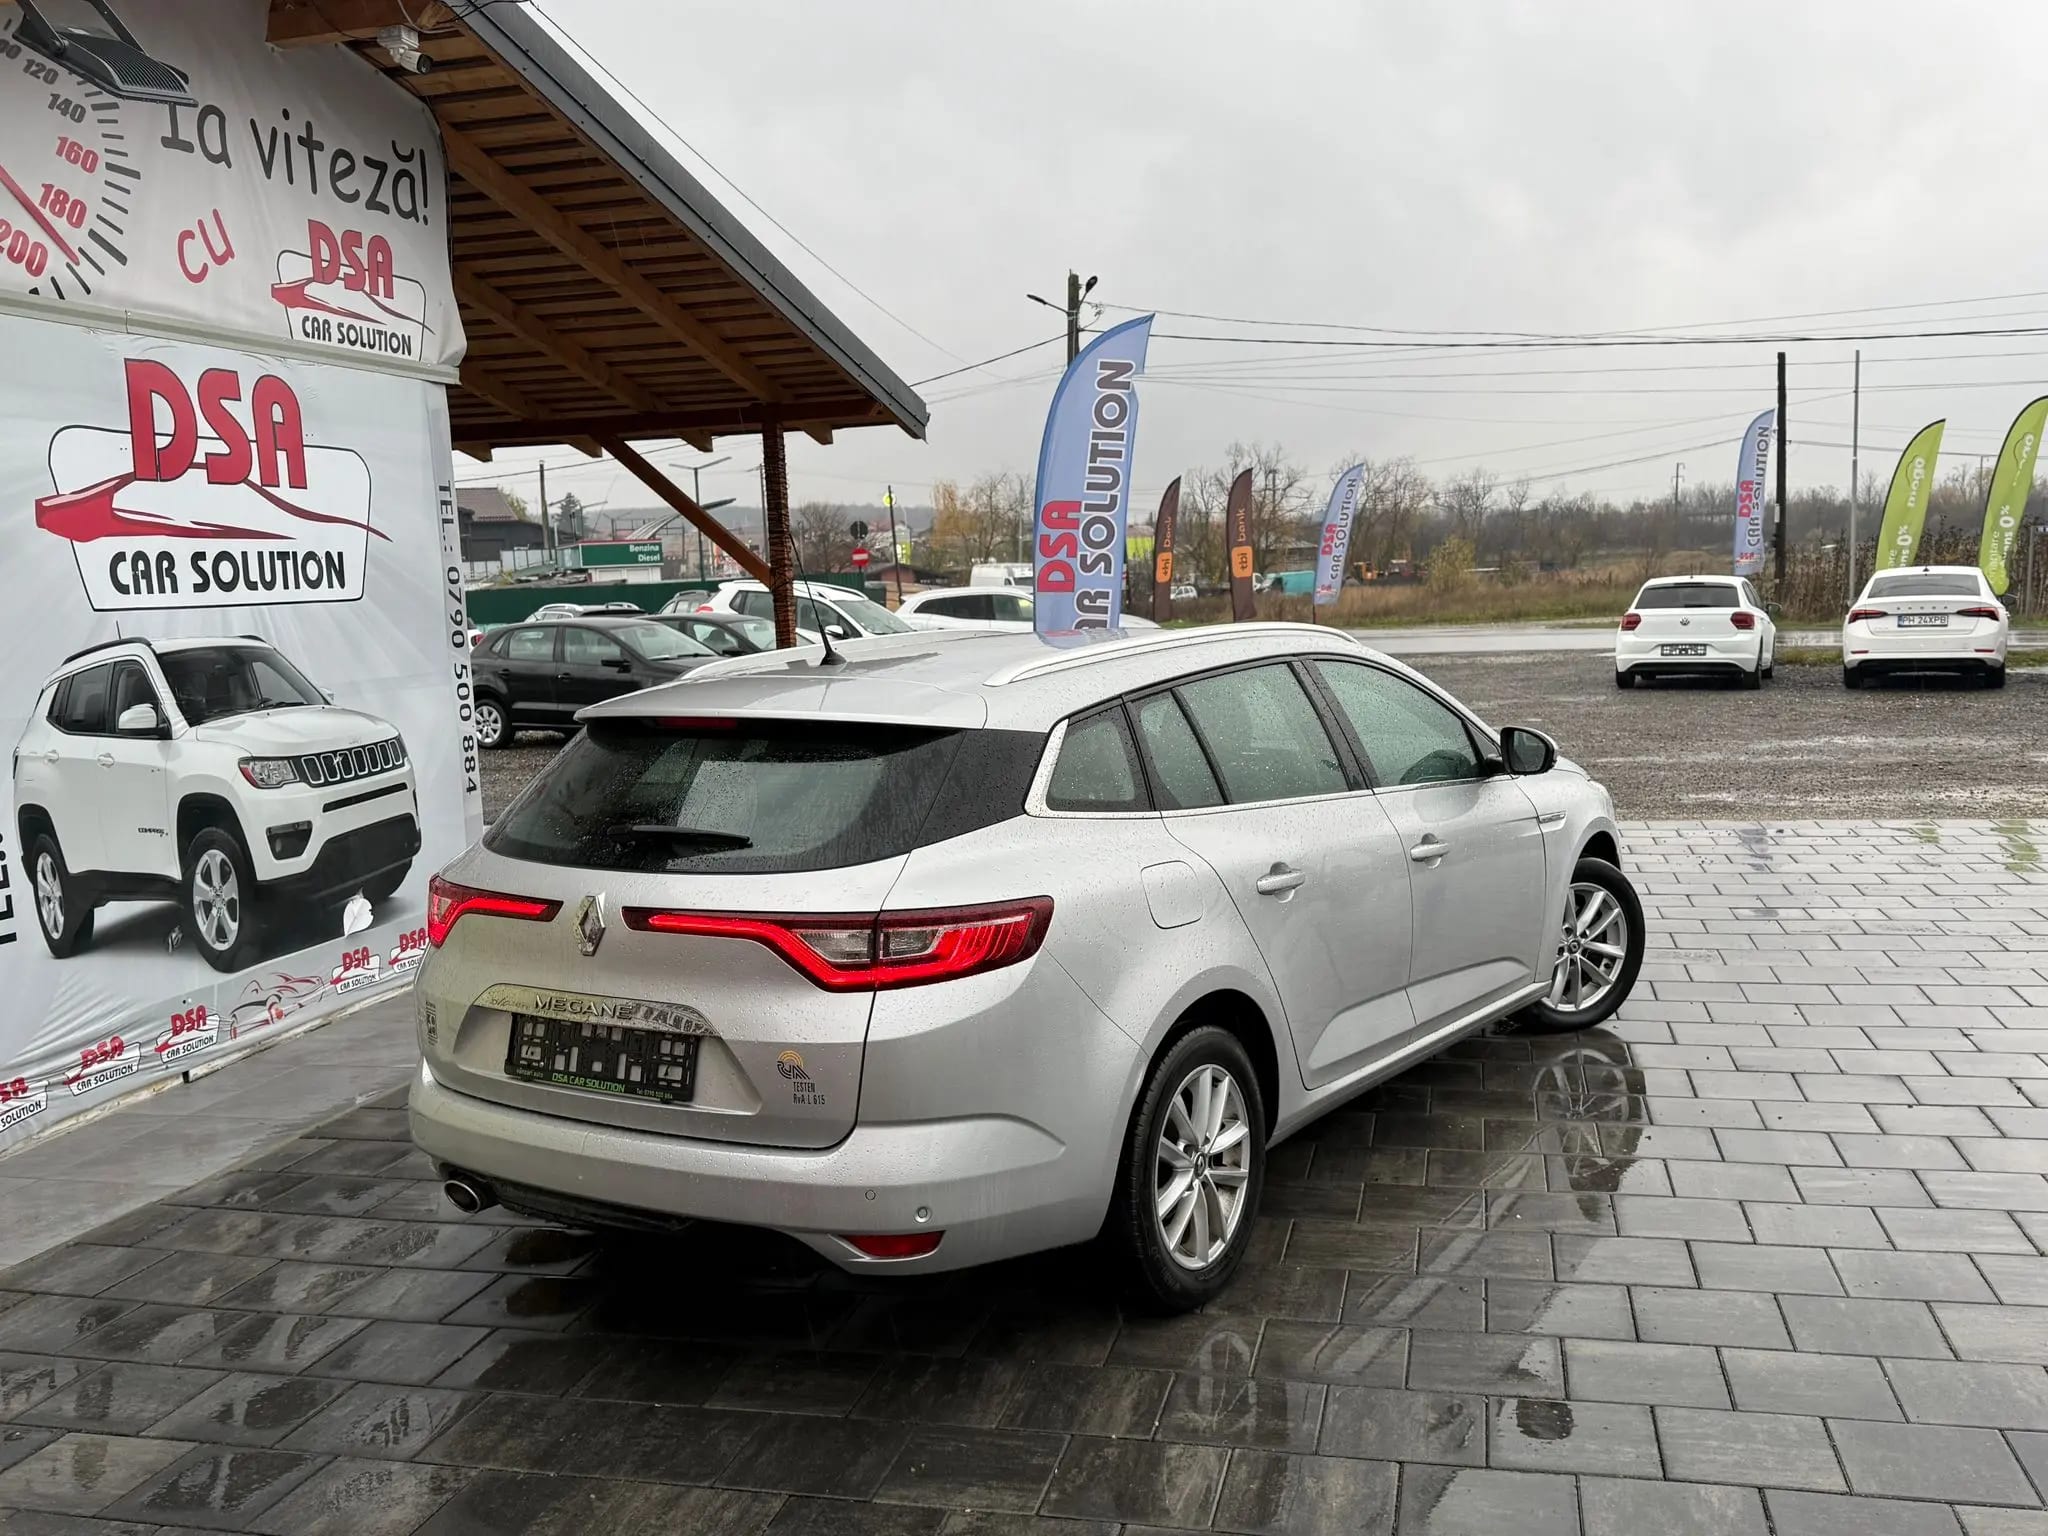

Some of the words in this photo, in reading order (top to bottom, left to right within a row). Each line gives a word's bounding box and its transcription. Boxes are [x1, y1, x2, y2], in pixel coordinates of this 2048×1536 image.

[22, 59, 59, 85] 120
[48, 93, 87, 124] 140
[55, 136, 99, 174] 160
[250, 108, 429, 225] viteză!
[38, 183, 87, 229] 180
[178, 209, 235, 283] cu
[307, 219, 395, 299] DSA
[302, 316, 332, 341] CAR
[337, 321, 412, 357] SOLUTION
[124, 358, 308, 490] DSA
[1079, 359, 1134, 575] SOLUTION
[1752, 426, 1770, 511] SOLUTION
[1334, 478, 1358, 549] SOLUTION
[1739, 480, 1754, 518] DSA
[1236, 508, 1247, 542] bank
[1321, 522, 1337, 556] DSA
[1747, 516, 1761, 546] CAR
[629, 544, 659, 553] Benzina
[638, 553, 660, 562] Diesel
[1036, 499, 1082, 593] DSA
[1237, 552, 1248, 572] tbi
[109, 551, 178, 595] CAR
[192, 550, 346, 593] SOLUTION
[1330, 554, 1343, 580] CAR
[447, 566, 465, 649] 0790
[1903, 615, 1915, 624] PH
[454, 662, 472, 722] 500
[462, 735, 478, 795] 884
[399, 928, 426, 953] DSA
[342, 946, 370, 971] DSA
[340, 982, 351, 991] CAR
[351, 974, 377, 987] SOLUTION
[170, 1004, 207, 1037] DSA
[535, 995, 633, 1020] MEGANE
[80, 1035, 124, 1070] DSA
[166, 1048, 181, 1059] CAR
[182, 1035, 214, 1053] SOLUTION
[77, 1079, 92, 1092] CAR
[94, 1063, 134, 1085] SOLUTION
[552, 1072, 568, 1082] DSA
[568, 1075, 586, 1086] CAR
[586, 1078, 625, 1093] SOLUTION
[0, 1100, 42, 1128] SOLUTION
[813, 1094, 826, 1105] 615
